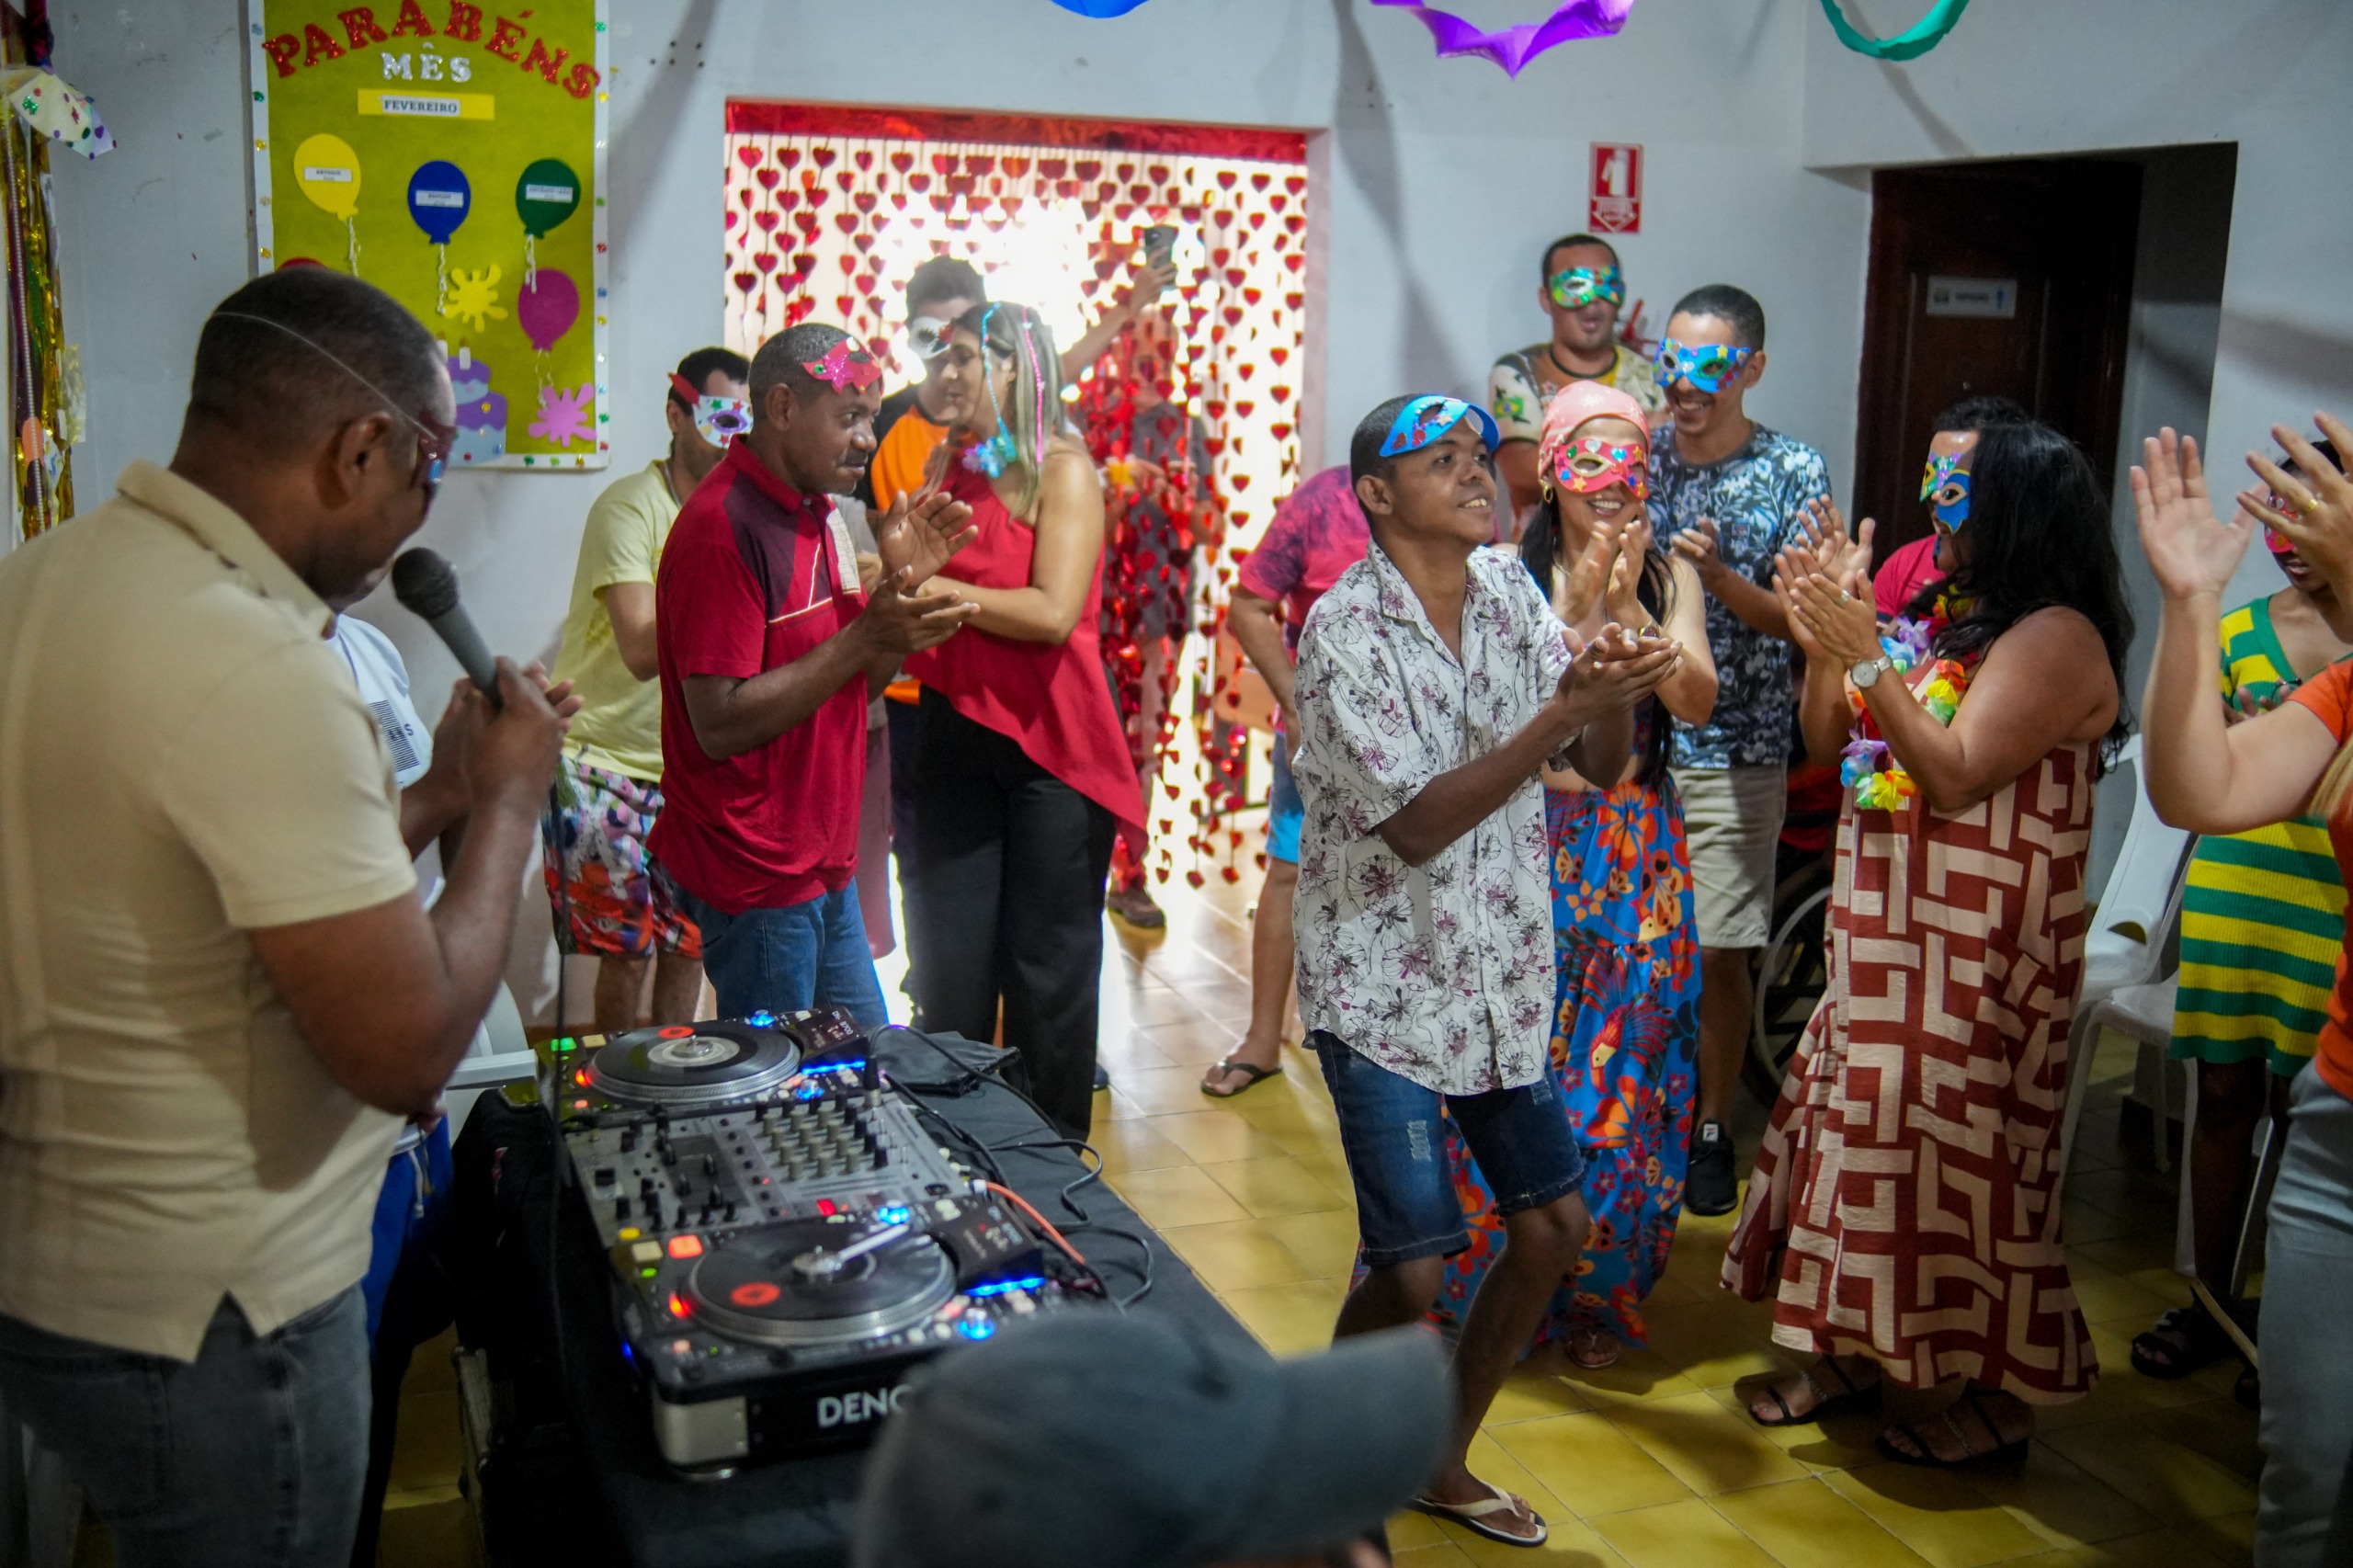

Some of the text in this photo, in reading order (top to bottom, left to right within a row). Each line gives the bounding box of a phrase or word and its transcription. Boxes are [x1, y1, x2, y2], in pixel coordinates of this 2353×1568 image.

[262, 0, 601, 99] PARABÉNS
[381, 41, 472, 83] MÊS
[383, 99, 458, 114] FEVEREIRO
